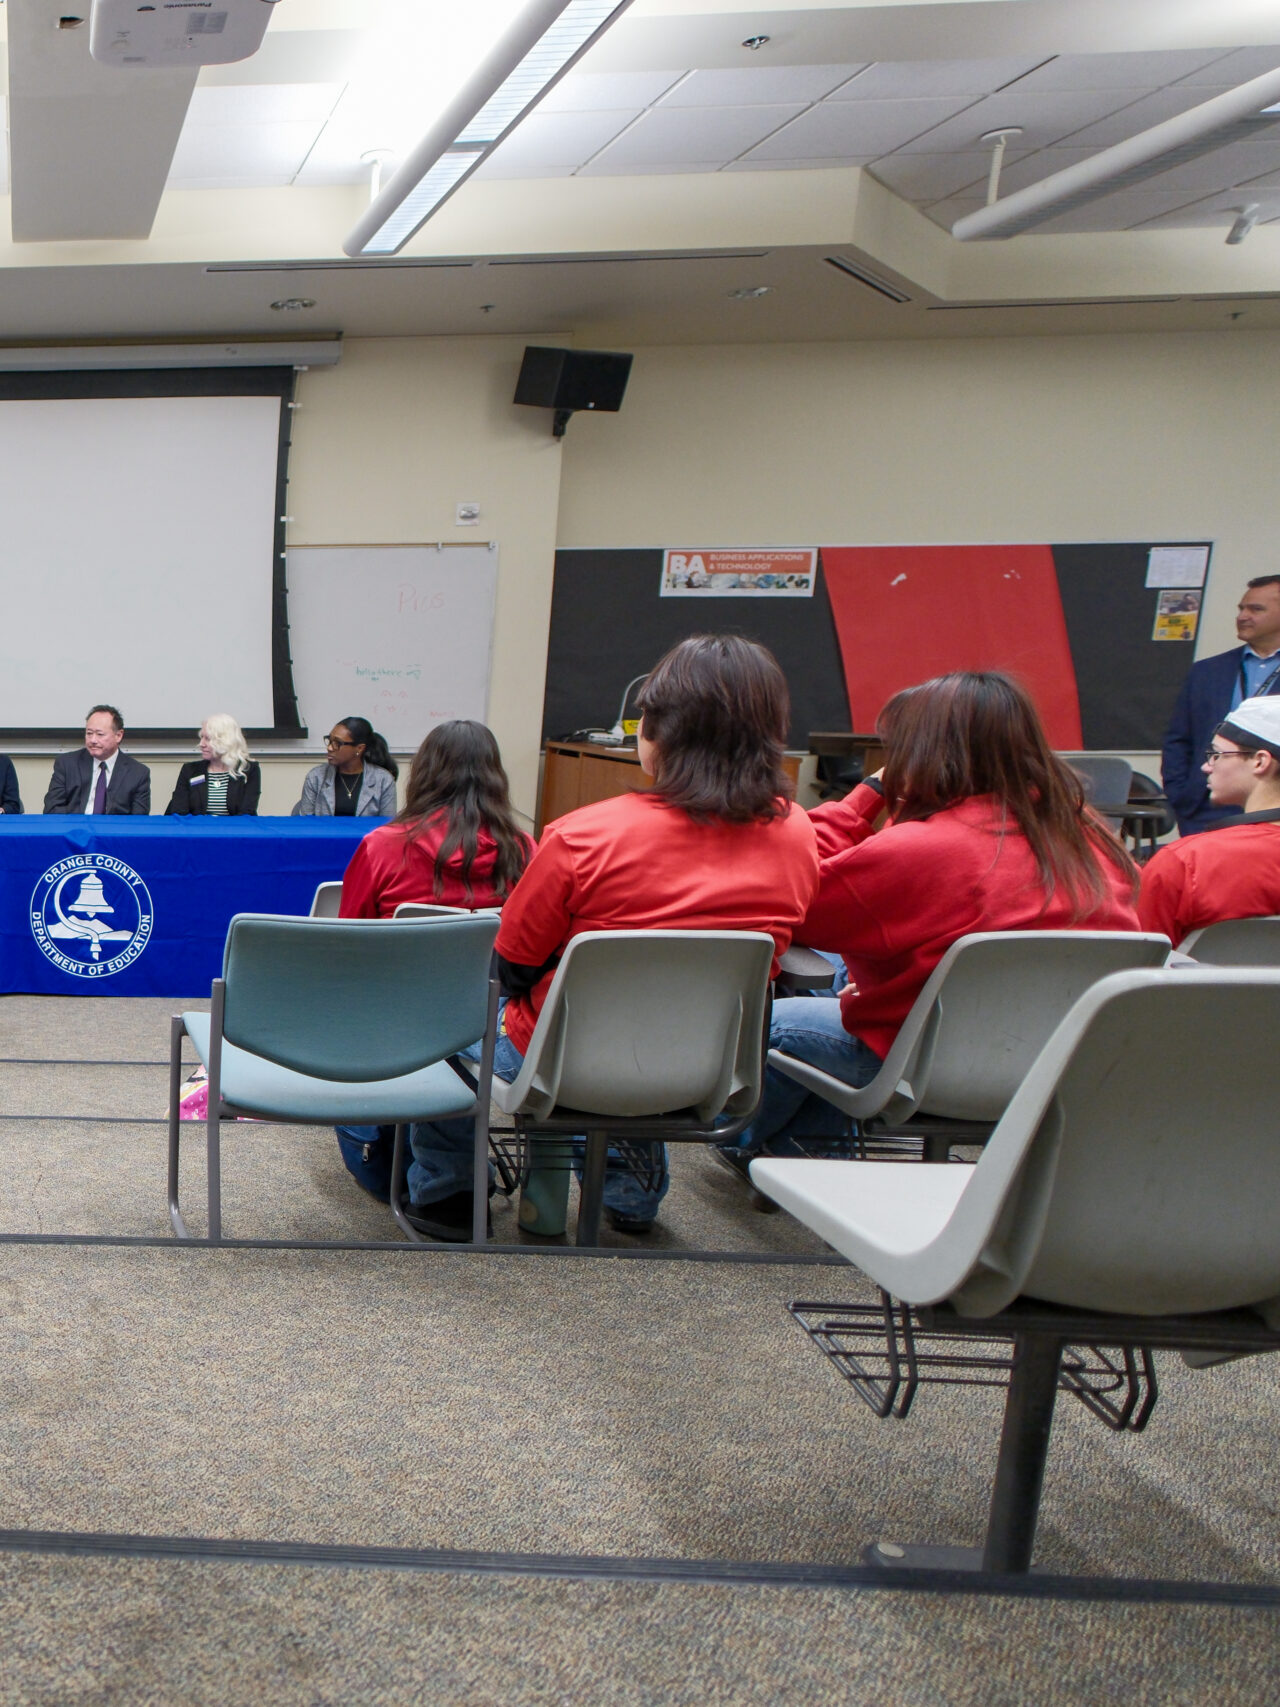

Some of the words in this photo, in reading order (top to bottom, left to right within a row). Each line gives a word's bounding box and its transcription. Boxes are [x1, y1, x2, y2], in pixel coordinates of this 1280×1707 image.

[670, 554, 707, 574] BA
[44, 856, 93, 884] ORANGE
[96, 856, 142, 887] COUNTY
[32, 911, 85, 974] DEPARTMENT
[88, 966, 105, 976] OF
[107, 914, 151, 972] EDUCATION
